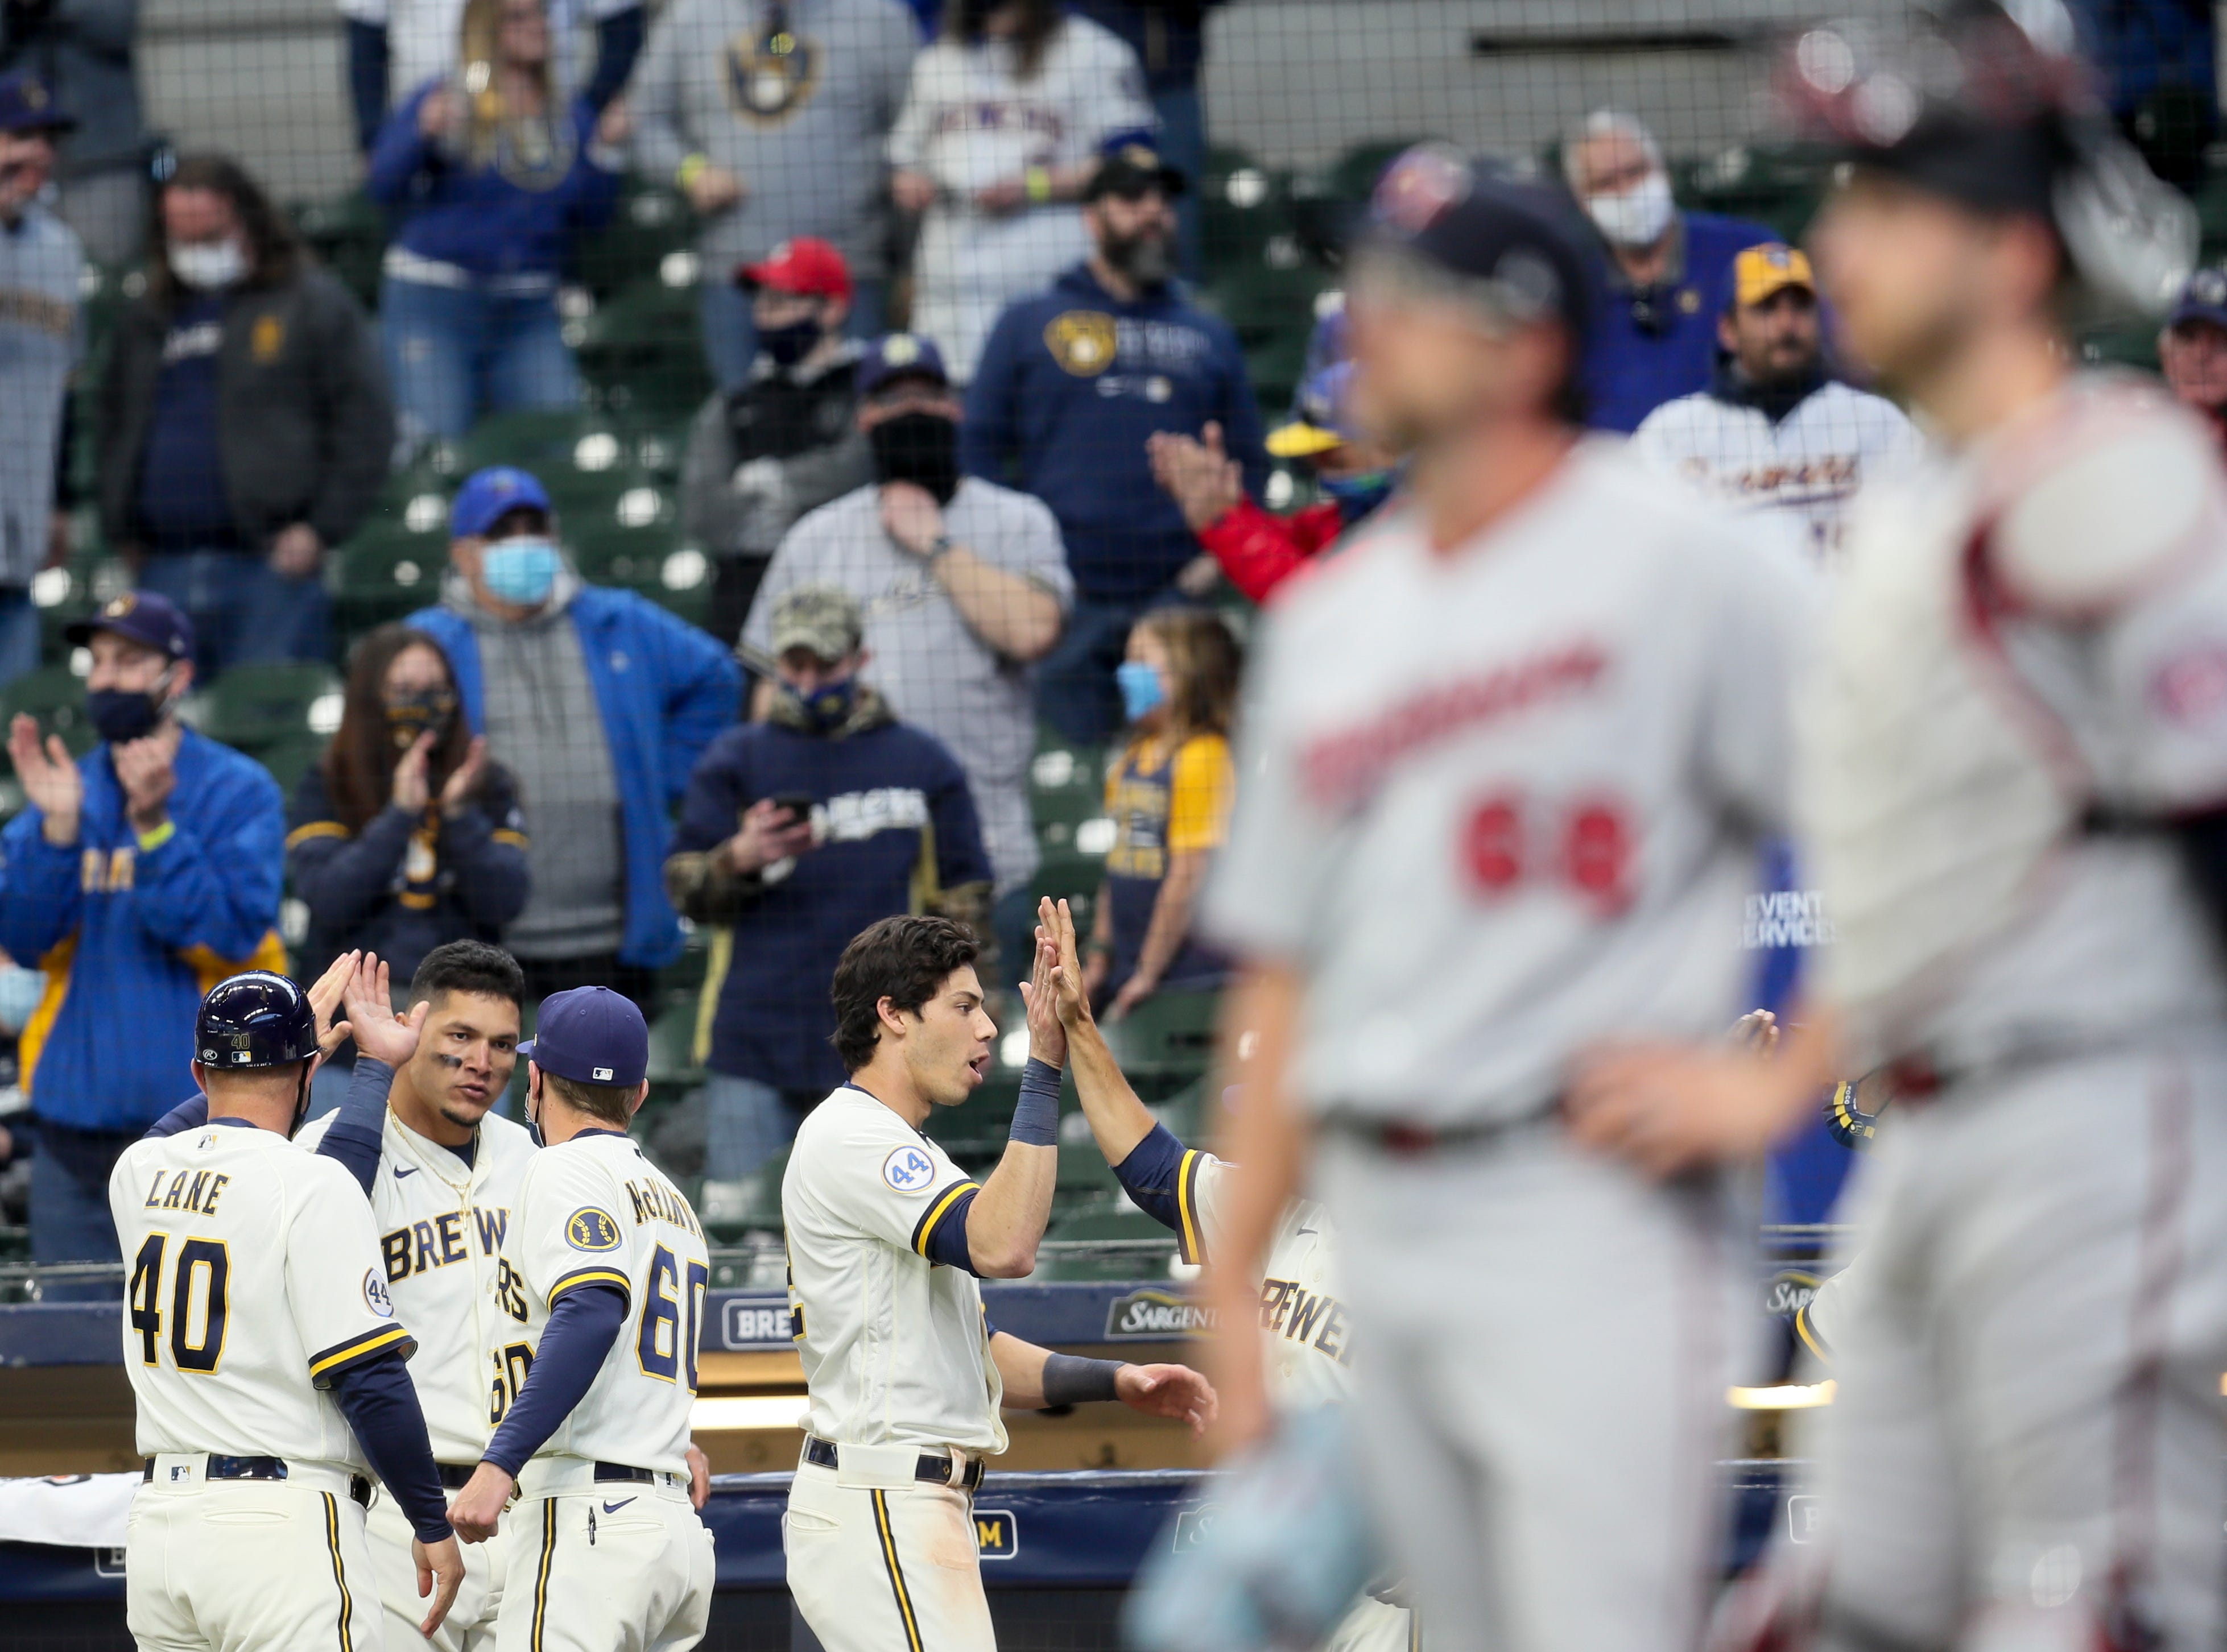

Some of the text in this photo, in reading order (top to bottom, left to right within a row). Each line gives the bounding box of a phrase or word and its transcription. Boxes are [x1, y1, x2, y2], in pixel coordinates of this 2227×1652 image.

[1745, 891, 1824, 921] EVENT
[231, 1033, 250, 1050] 40
[892, 1152, 929, 1183] 44
[144, 1169, 232, 1217] LANE
[129, 1231, 232, 1375] 40
[368, 1278, 391, 1306] 44
[634, 1239, 709, 1397] 60
[1120, 1301, 1223, 1332] SARGENT
